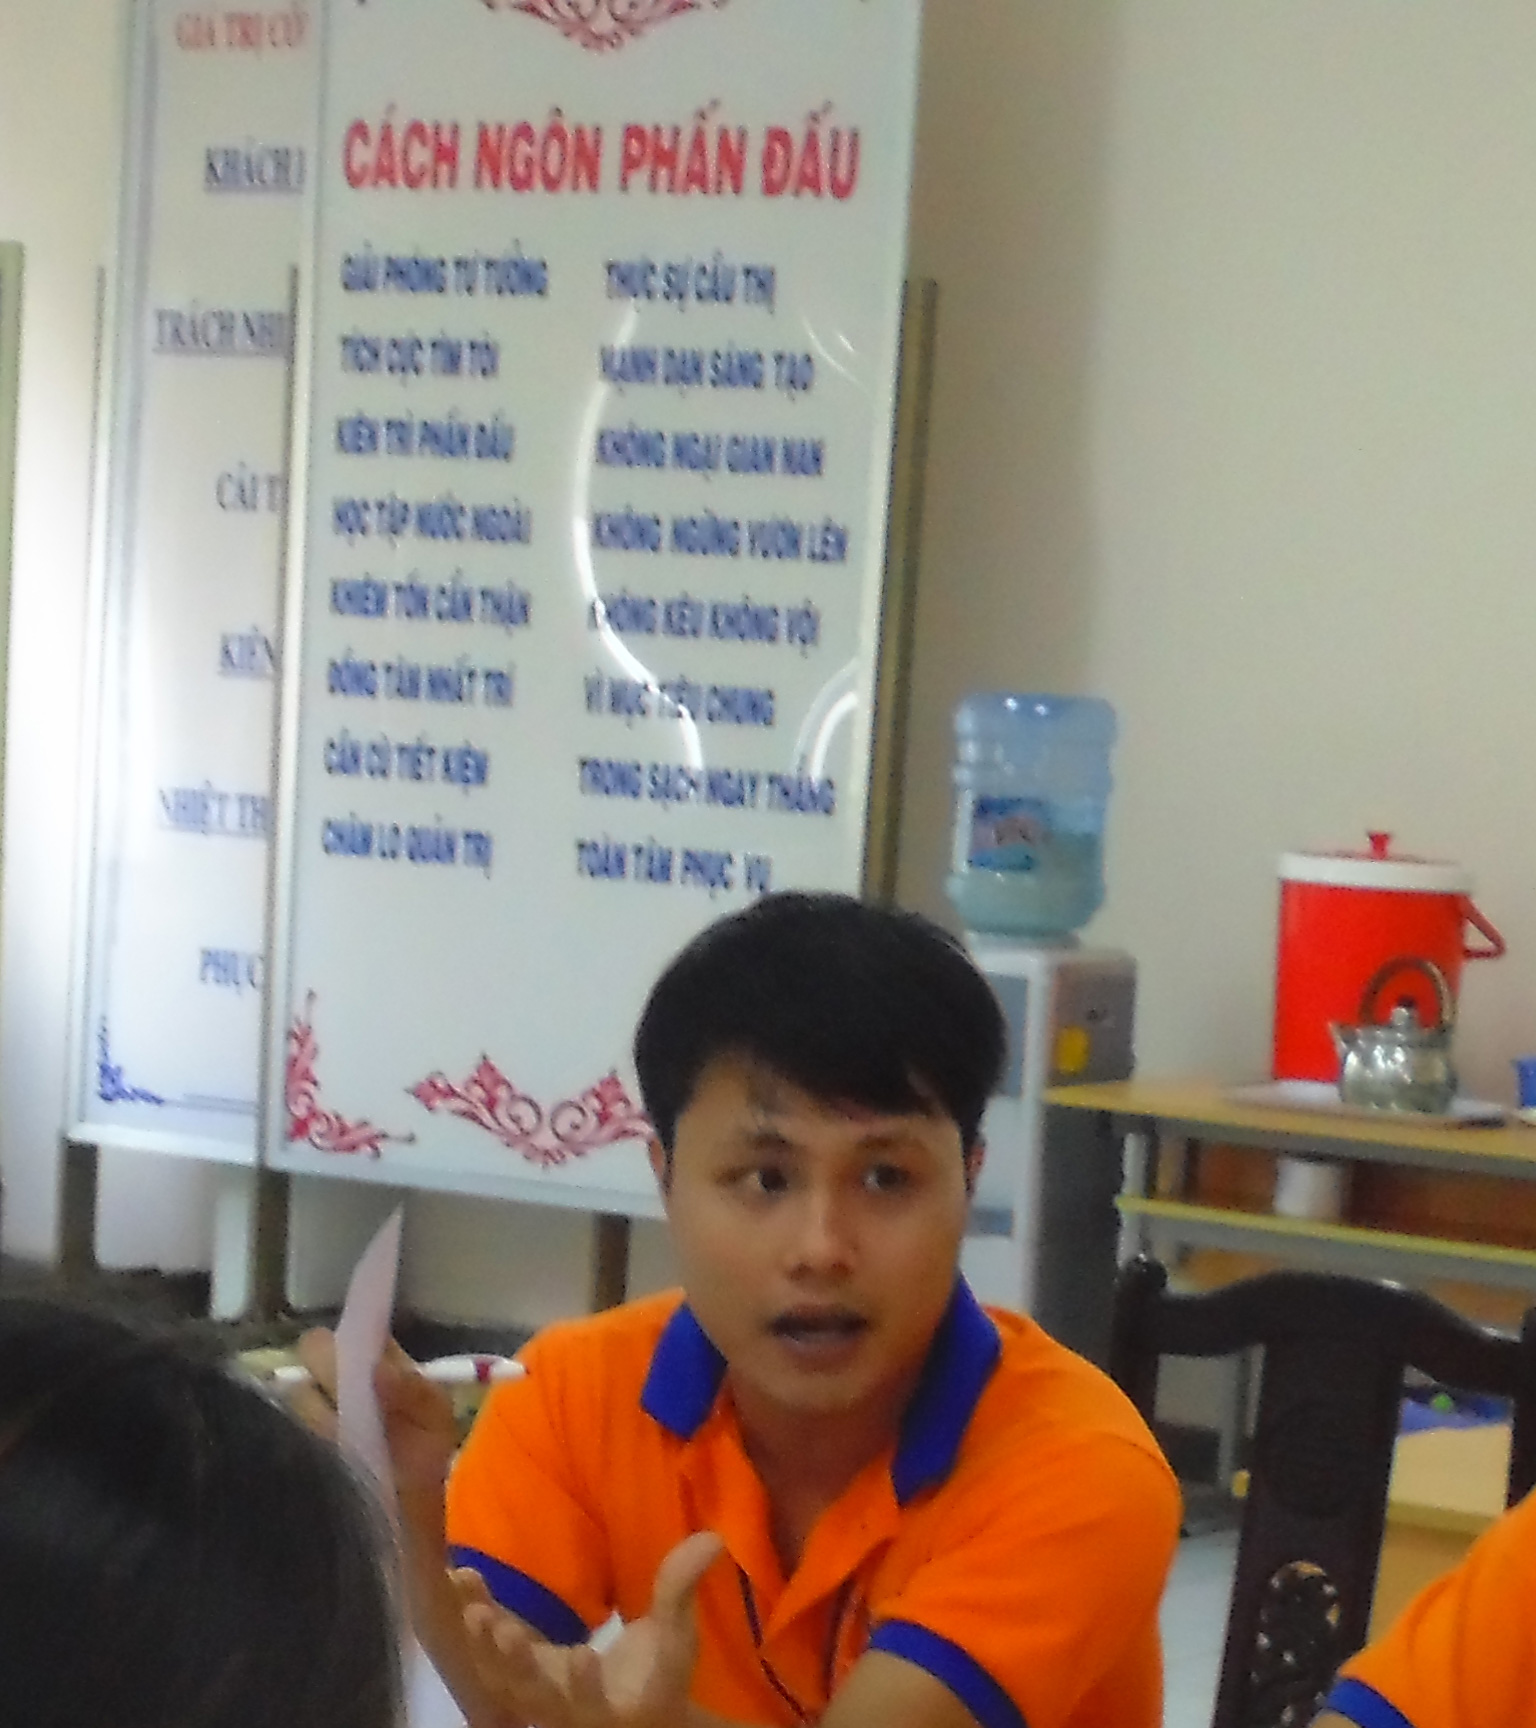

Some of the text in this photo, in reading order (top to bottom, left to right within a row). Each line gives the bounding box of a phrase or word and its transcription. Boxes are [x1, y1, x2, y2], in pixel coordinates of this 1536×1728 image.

[343, 103, 461, 190] CÁCH
[473, 106, 603, 193] NGÔN
[620, 98, 750, 198] PHẤN
[762, 99, 860, 201] ĐẤU
[597, 420, 666, 468] KHÔNG
[592, 503, 662, 551] KHÔNG
[806, 515, 848, 564] LÊN
[711, 593, 781, 646] KHÔNG
[706, 685, 776, 727] CHUNG
[578, 758, 642, 798] TRONG
[376, 821, 402, 860] LO
[680, 848, 735, 900] PHỤC
